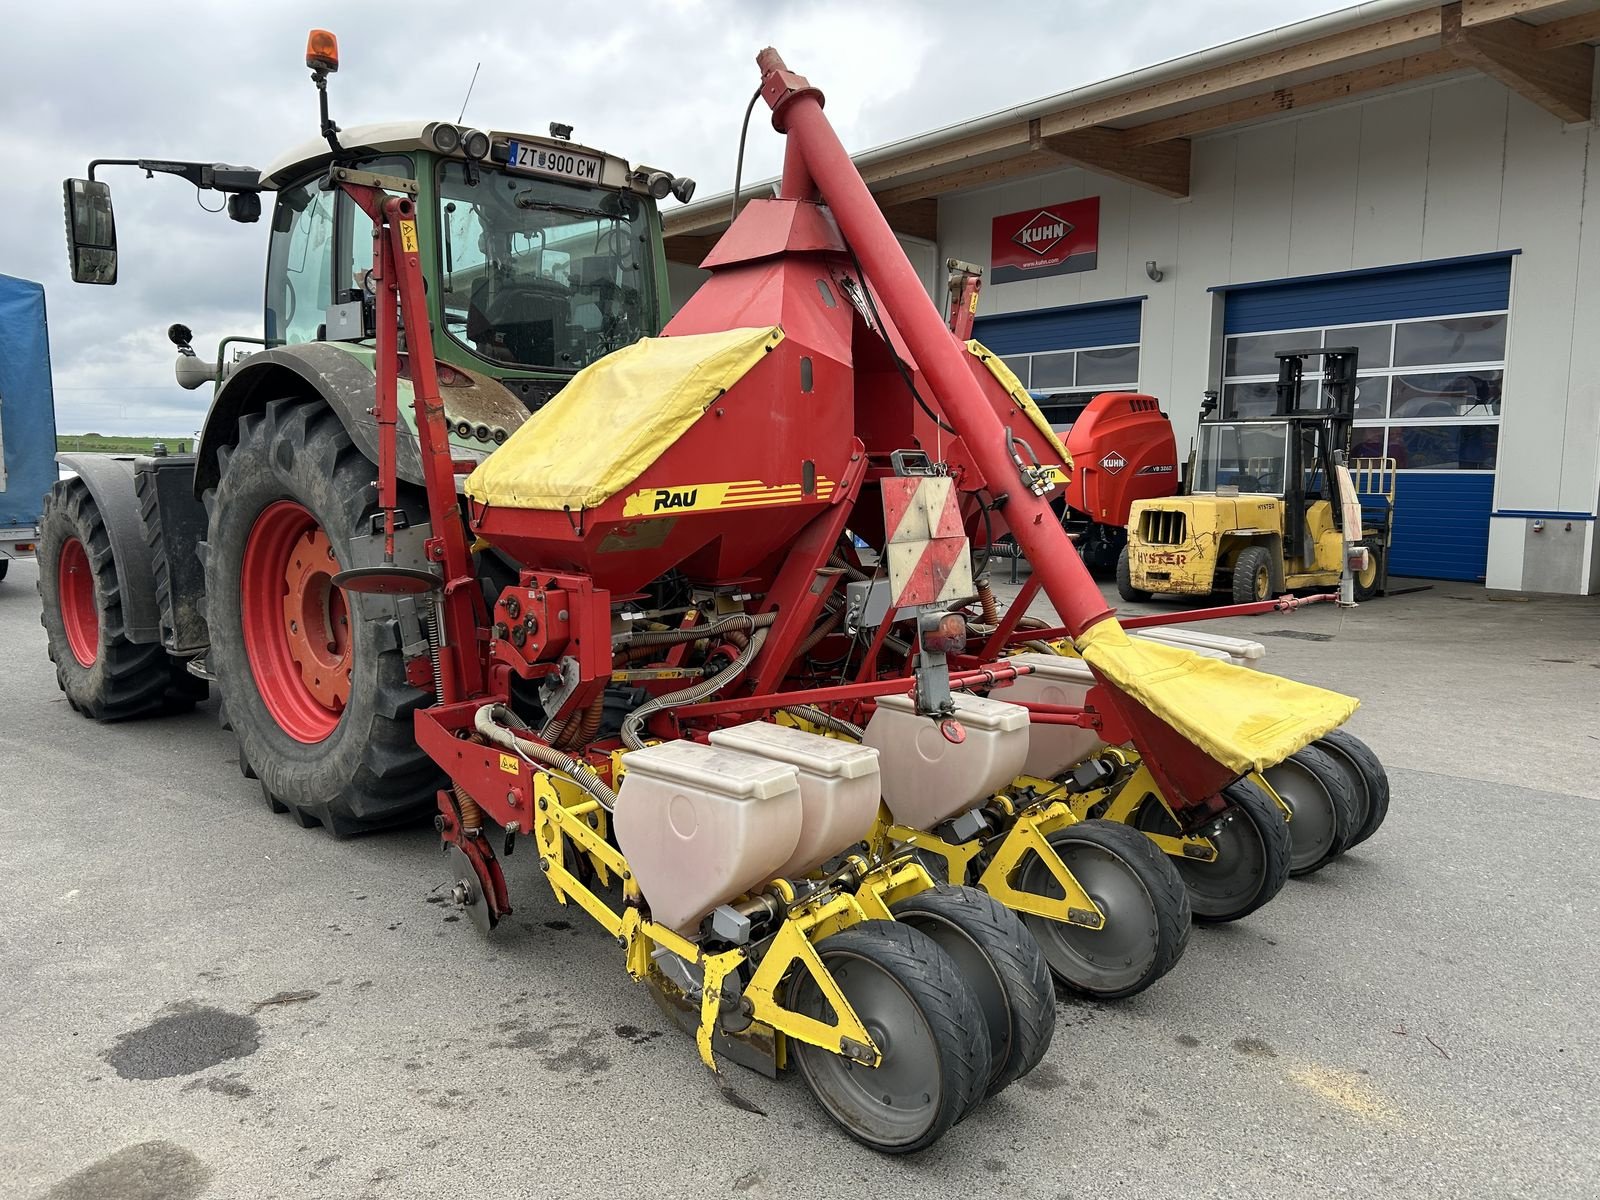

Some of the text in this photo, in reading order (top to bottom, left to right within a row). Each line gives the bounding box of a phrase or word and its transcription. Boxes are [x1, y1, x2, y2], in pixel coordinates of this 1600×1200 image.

[519, 147, 538, 167] ZT
[547, 153, 574, 174] 900
[576, 158, 597, 178] CW
[1022, 222, 1064, 244] KUHN
[1022, 258, 1060, 268] www.kuhn.com
[1103, 459, 1124, 468] KUHN
[1137, 552, 1187, 565] HYSTER
